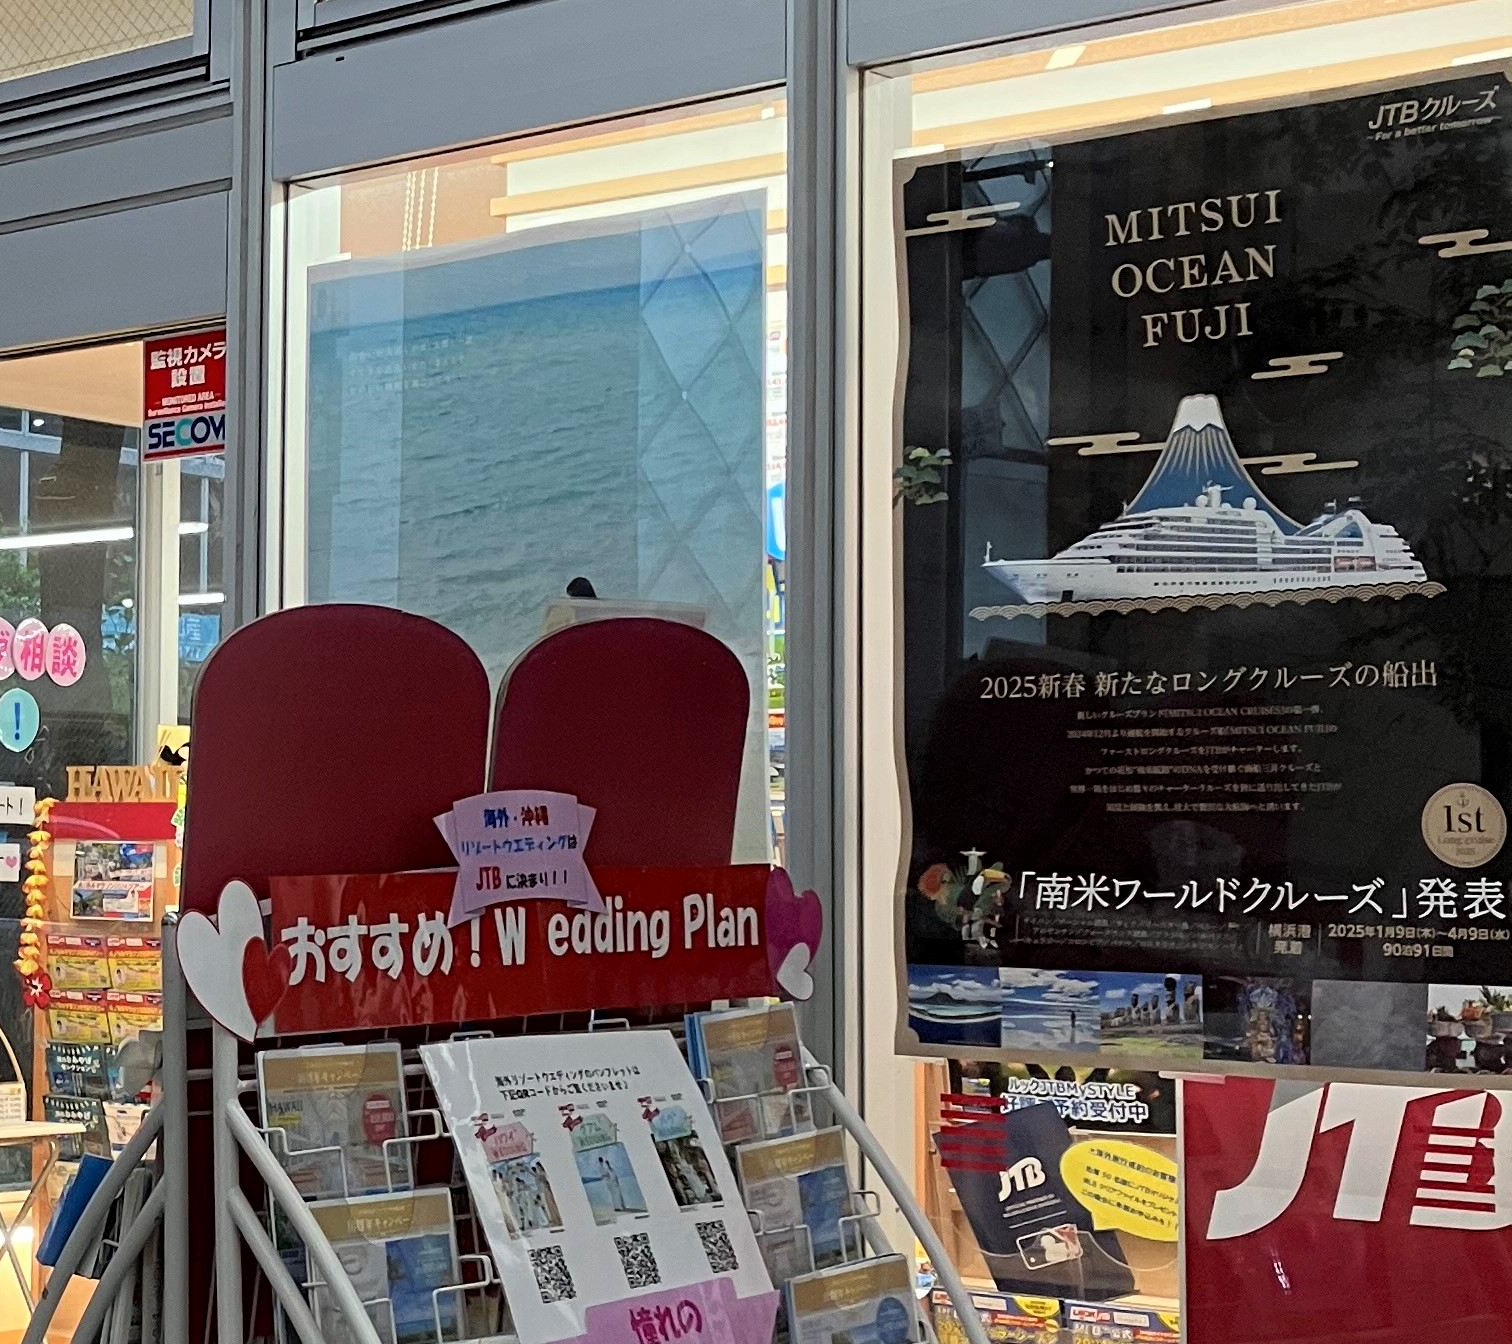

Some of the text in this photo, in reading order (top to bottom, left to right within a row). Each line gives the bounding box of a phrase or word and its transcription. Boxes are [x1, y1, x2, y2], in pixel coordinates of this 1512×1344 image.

[1368, 84, 1500, 130] JTBクルーズ
[1104, 189, 1284, 247] MITSUI
[1111, 244, 1276, 298] OCEAN
[1141, 302, 1254, 349] FUJI
[150, 341, 226, 370] 監視カメラ
[979, 658, 1438, 700] 2025新春 新たなロングクルーズの船出
[1443, 805, 1486, 833] 1st
[476, 866, 502, 891] JTB
[1018, 870, 1508, 921] 「南米ワールドクルーズ」発表
[684, 892, 760, 951] Plan
[998, 1157, 1046, 1203] JTB
